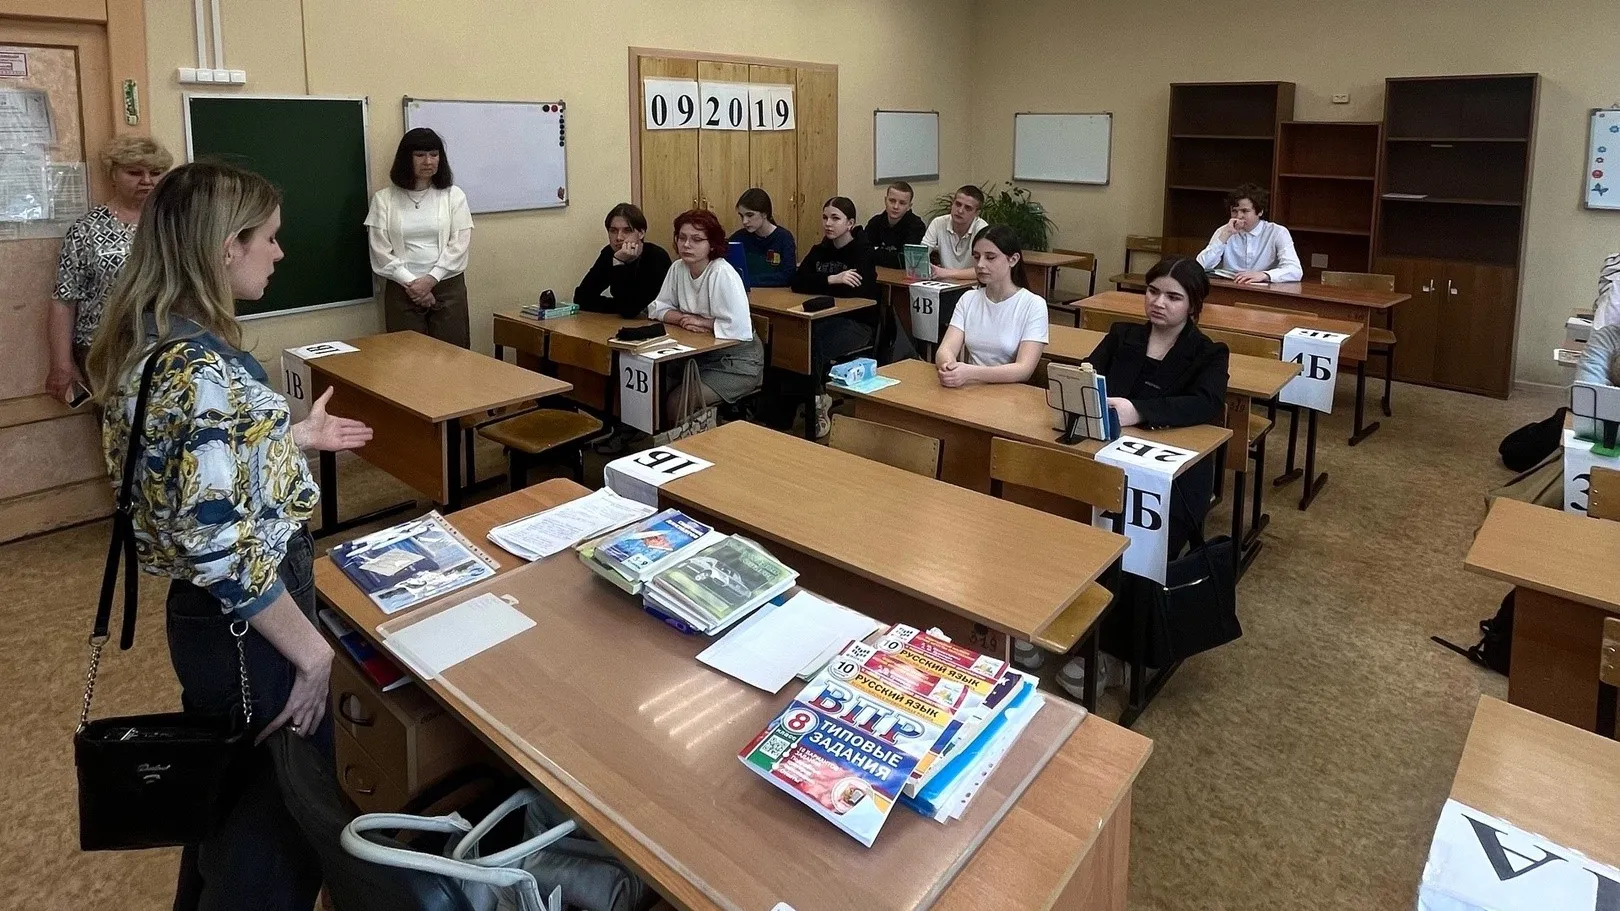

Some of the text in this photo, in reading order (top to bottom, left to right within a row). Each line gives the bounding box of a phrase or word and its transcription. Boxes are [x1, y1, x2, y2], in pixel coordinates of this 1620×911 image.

[912, 296, 933, 315] 4В
[285, 369, 304, 400] 1В
[624, 366, 649, 394] 2В
[633, 450, 699, 475] 1Б
[1115, 441, 1187, 462] 2Б
[837, 661, 855, 674] 10
[900, 649, 947, 673] РУССКИЙ
[948, 671, 980, 687] ЯЗЫК
[855, 674, 905, 703] РУССКИЙ
[905, 699, 940, 718] ЯЗЫК
[787, 713, 811, 731] 8
[808, 680, 925, 746] ВПР
[809, 732, 892, 781] ЗАДАНИЯ
[820, 720, 904, 768] ТИПОВЫЕ
